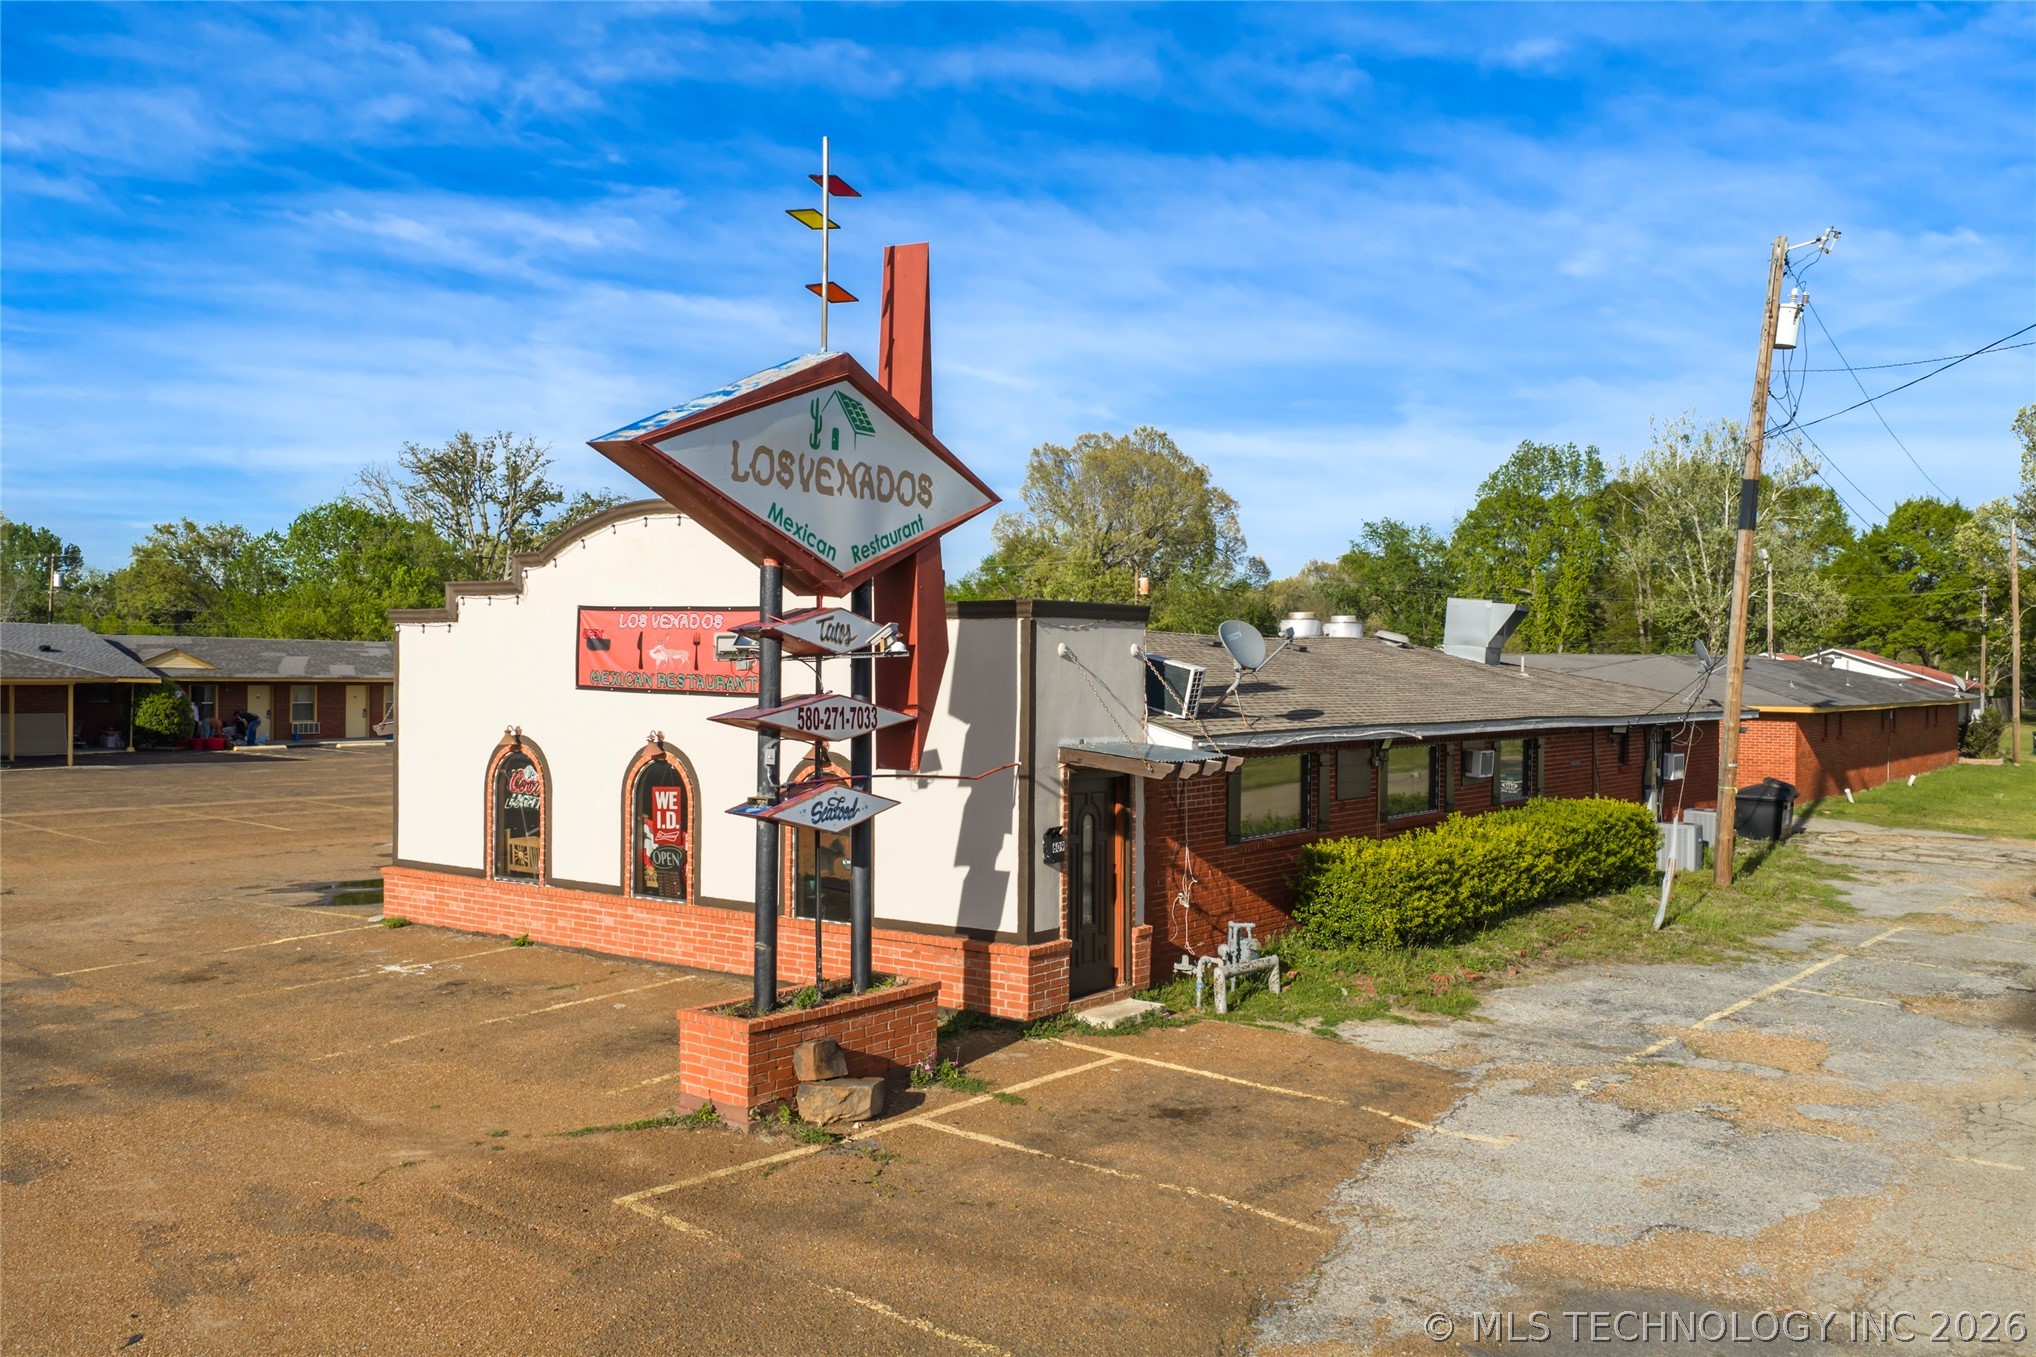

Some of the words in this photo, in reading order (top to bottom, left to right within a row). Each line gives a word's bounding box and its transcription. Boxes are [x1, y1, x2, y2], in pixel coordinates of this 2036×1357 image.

[767, 502, 837, 562] Mexican
[851, 513, 925, 564] Restaurant
[618, 613, 648, 629] LOS
[651, 613, 724, 630] VENADOS
[816, 615, 858, 646] Tacos
[590, 670, 654, 688] MEXICAN
[657, 672, 759, 692] RESTAURANT
[797, 706, 879, 731] 580-271-7033
[655, 791, 678, 810] WE
[656, 811, 680, 830] I.D.
[653, 850, 680, 867] OPEN
